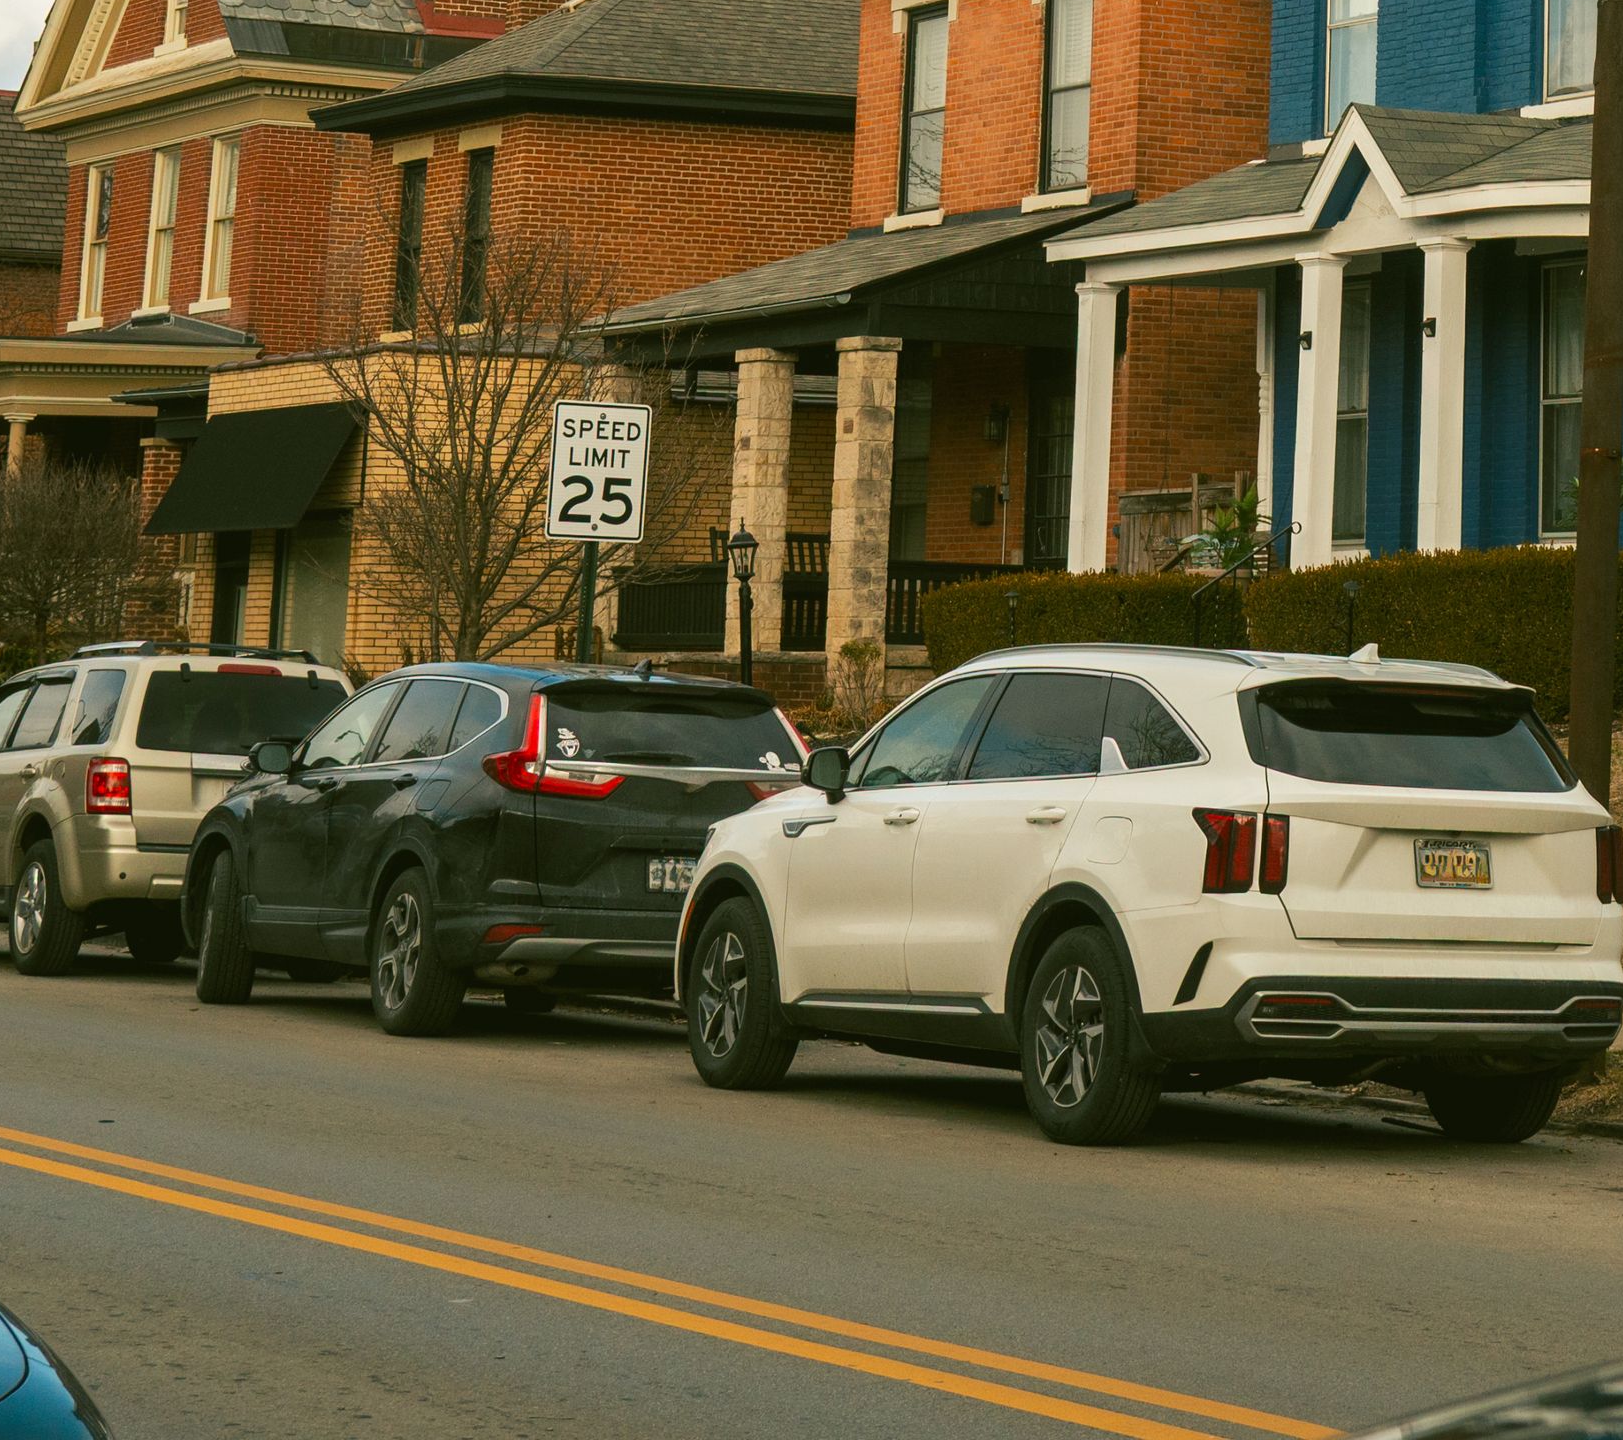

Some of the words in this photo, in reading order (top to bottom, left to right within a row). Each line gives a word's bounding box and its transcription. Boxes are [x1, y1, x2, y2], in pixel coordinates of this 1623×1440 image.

[562, 417, 641, 442] SPEED
[569, 446, 631, 469] LIMIT
[558, 474, 633, 526] 25
